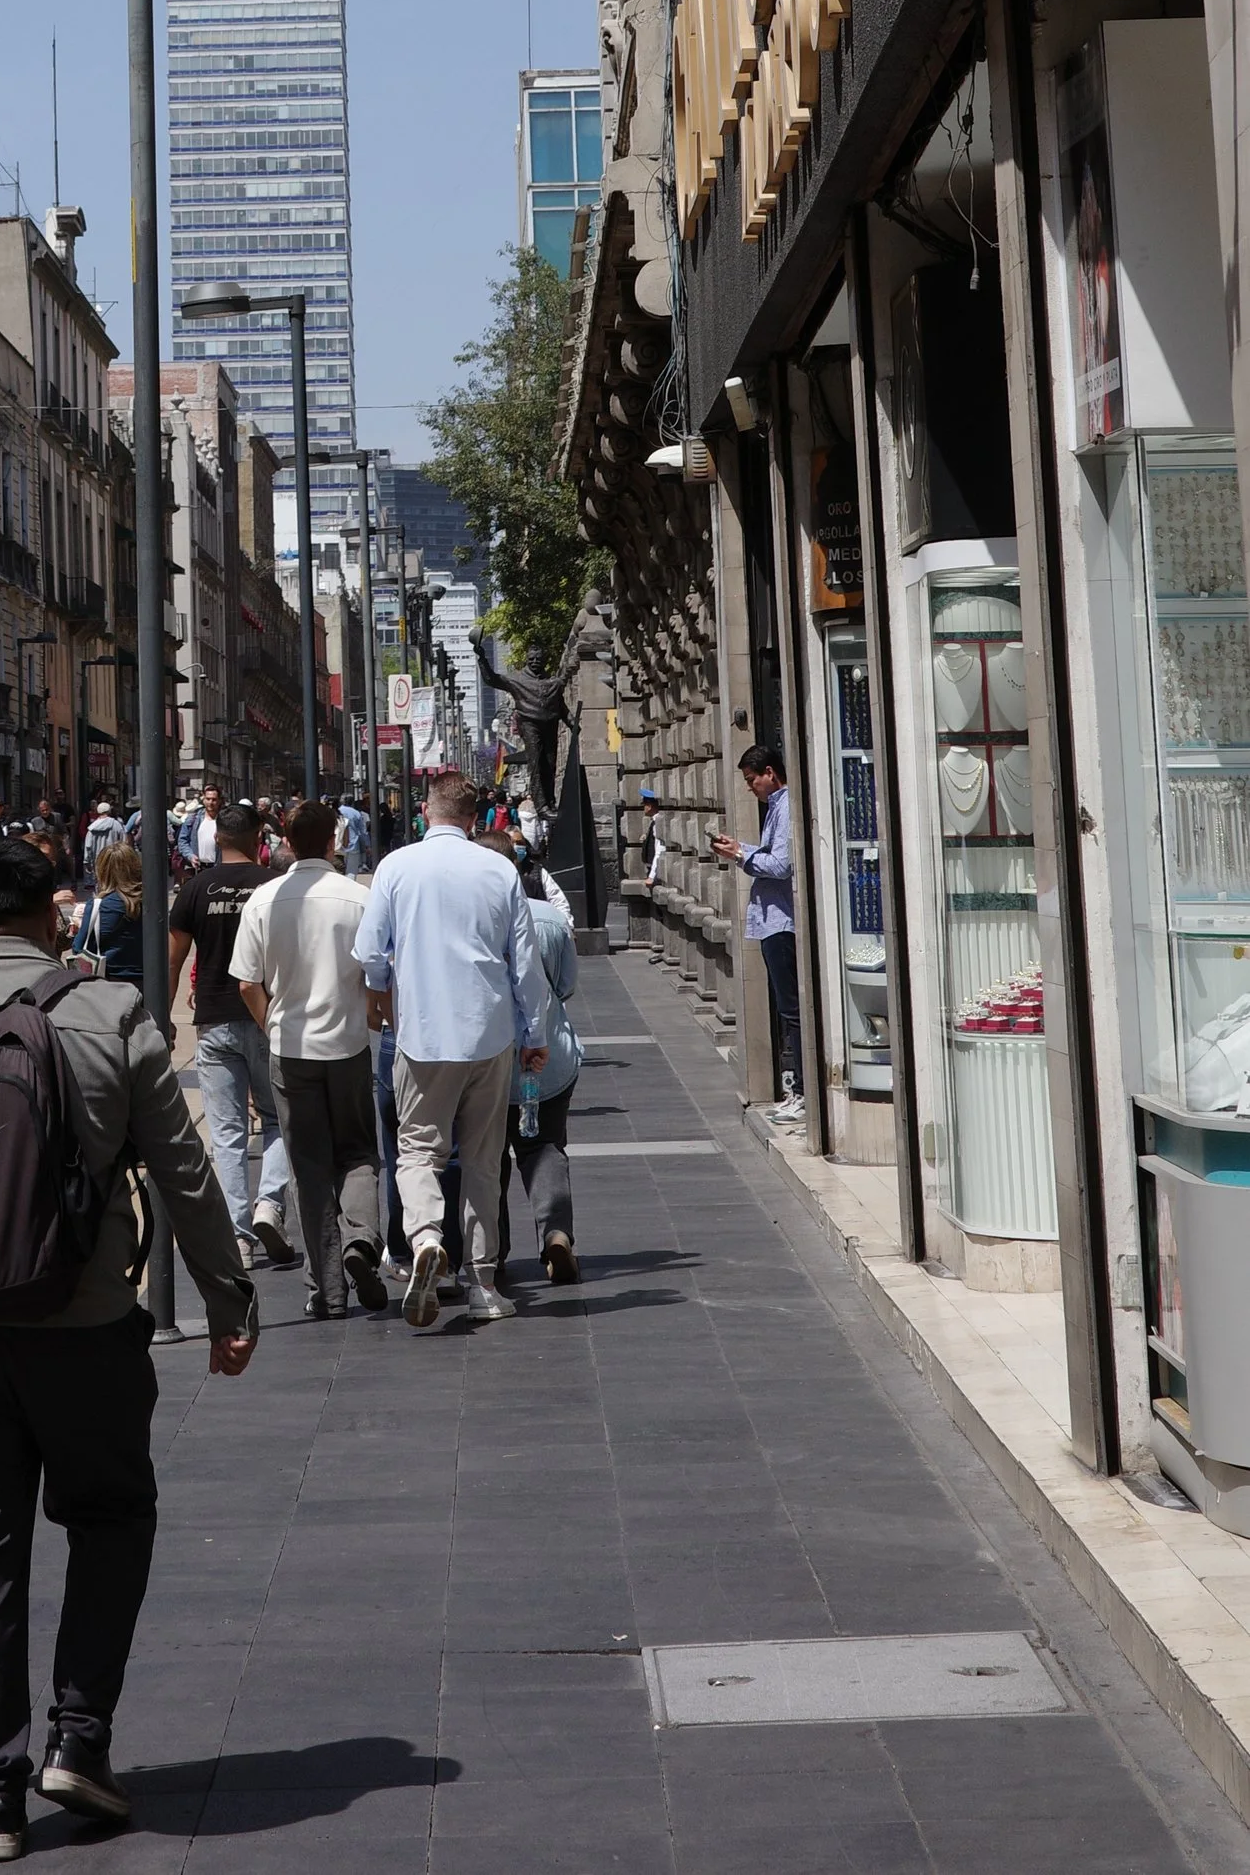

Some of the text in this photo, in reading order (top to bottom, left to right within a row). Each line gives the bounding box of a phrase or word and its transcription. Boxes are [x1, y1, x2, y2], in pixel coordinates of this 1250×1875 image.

[828, 501, 852, 516] ORO
[829, 548, 862, 561] MED
[206, 898, 246, 915] MÉX
